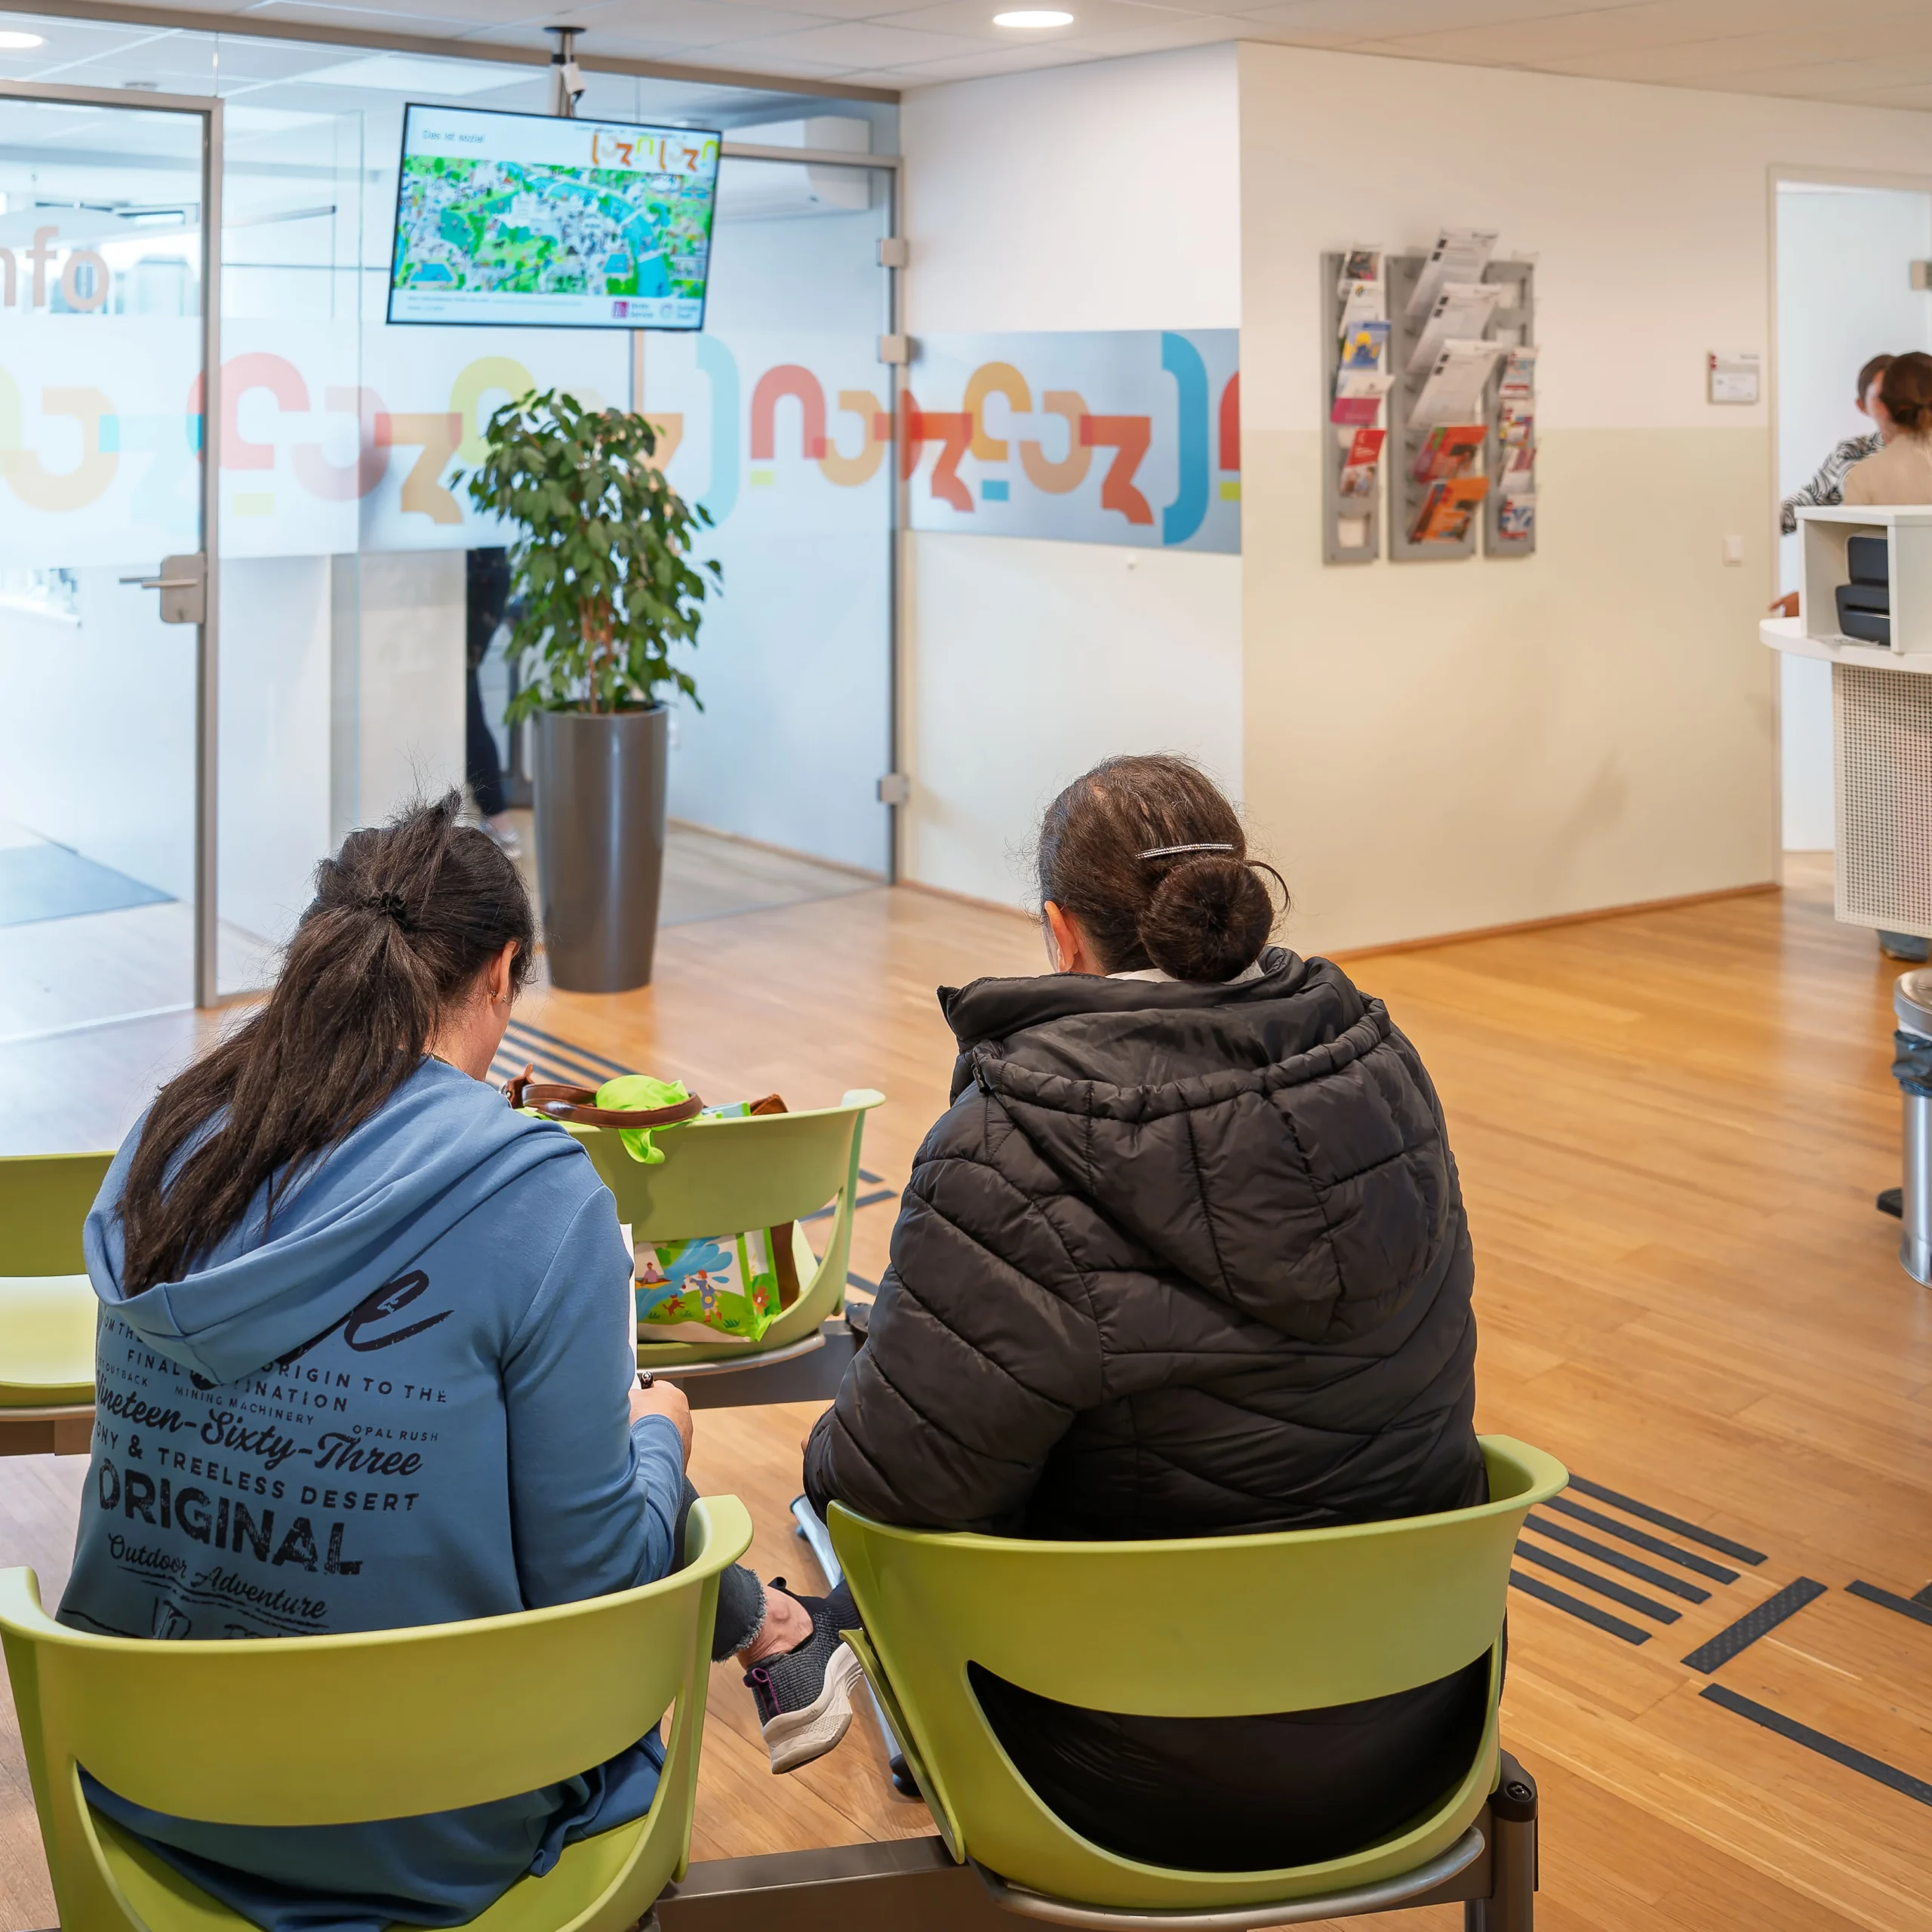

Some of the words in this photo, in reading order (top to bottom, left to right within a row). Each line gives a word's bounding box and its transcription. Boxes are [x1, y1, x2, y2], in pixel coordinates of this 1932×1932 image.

[127, 1349, 180, 1376] FINAL
[362, 1377, 393, 1395] TO
[404, 1384, 448, 1404] THE
[106, 1363, 149, 1387] OUTBACK
[175, 1386, 223, 1406] MINING
[229, 1398, 314, 1426] MACHINERY
[352, 1424, 393, 1440] OPAL
[399, 1429, 439, 1442] RUSH
[128, 1434, 143, 1460] &
[158, 1447, 285, 1500] TREELESS
[300, 1486, 420, 1512] DESERT
[98, 1457, 364, 1577] ORIGINAL
[107, 1532, 188, 1579] Outdoor
[190, 1566, 329, 1620] Adventure
